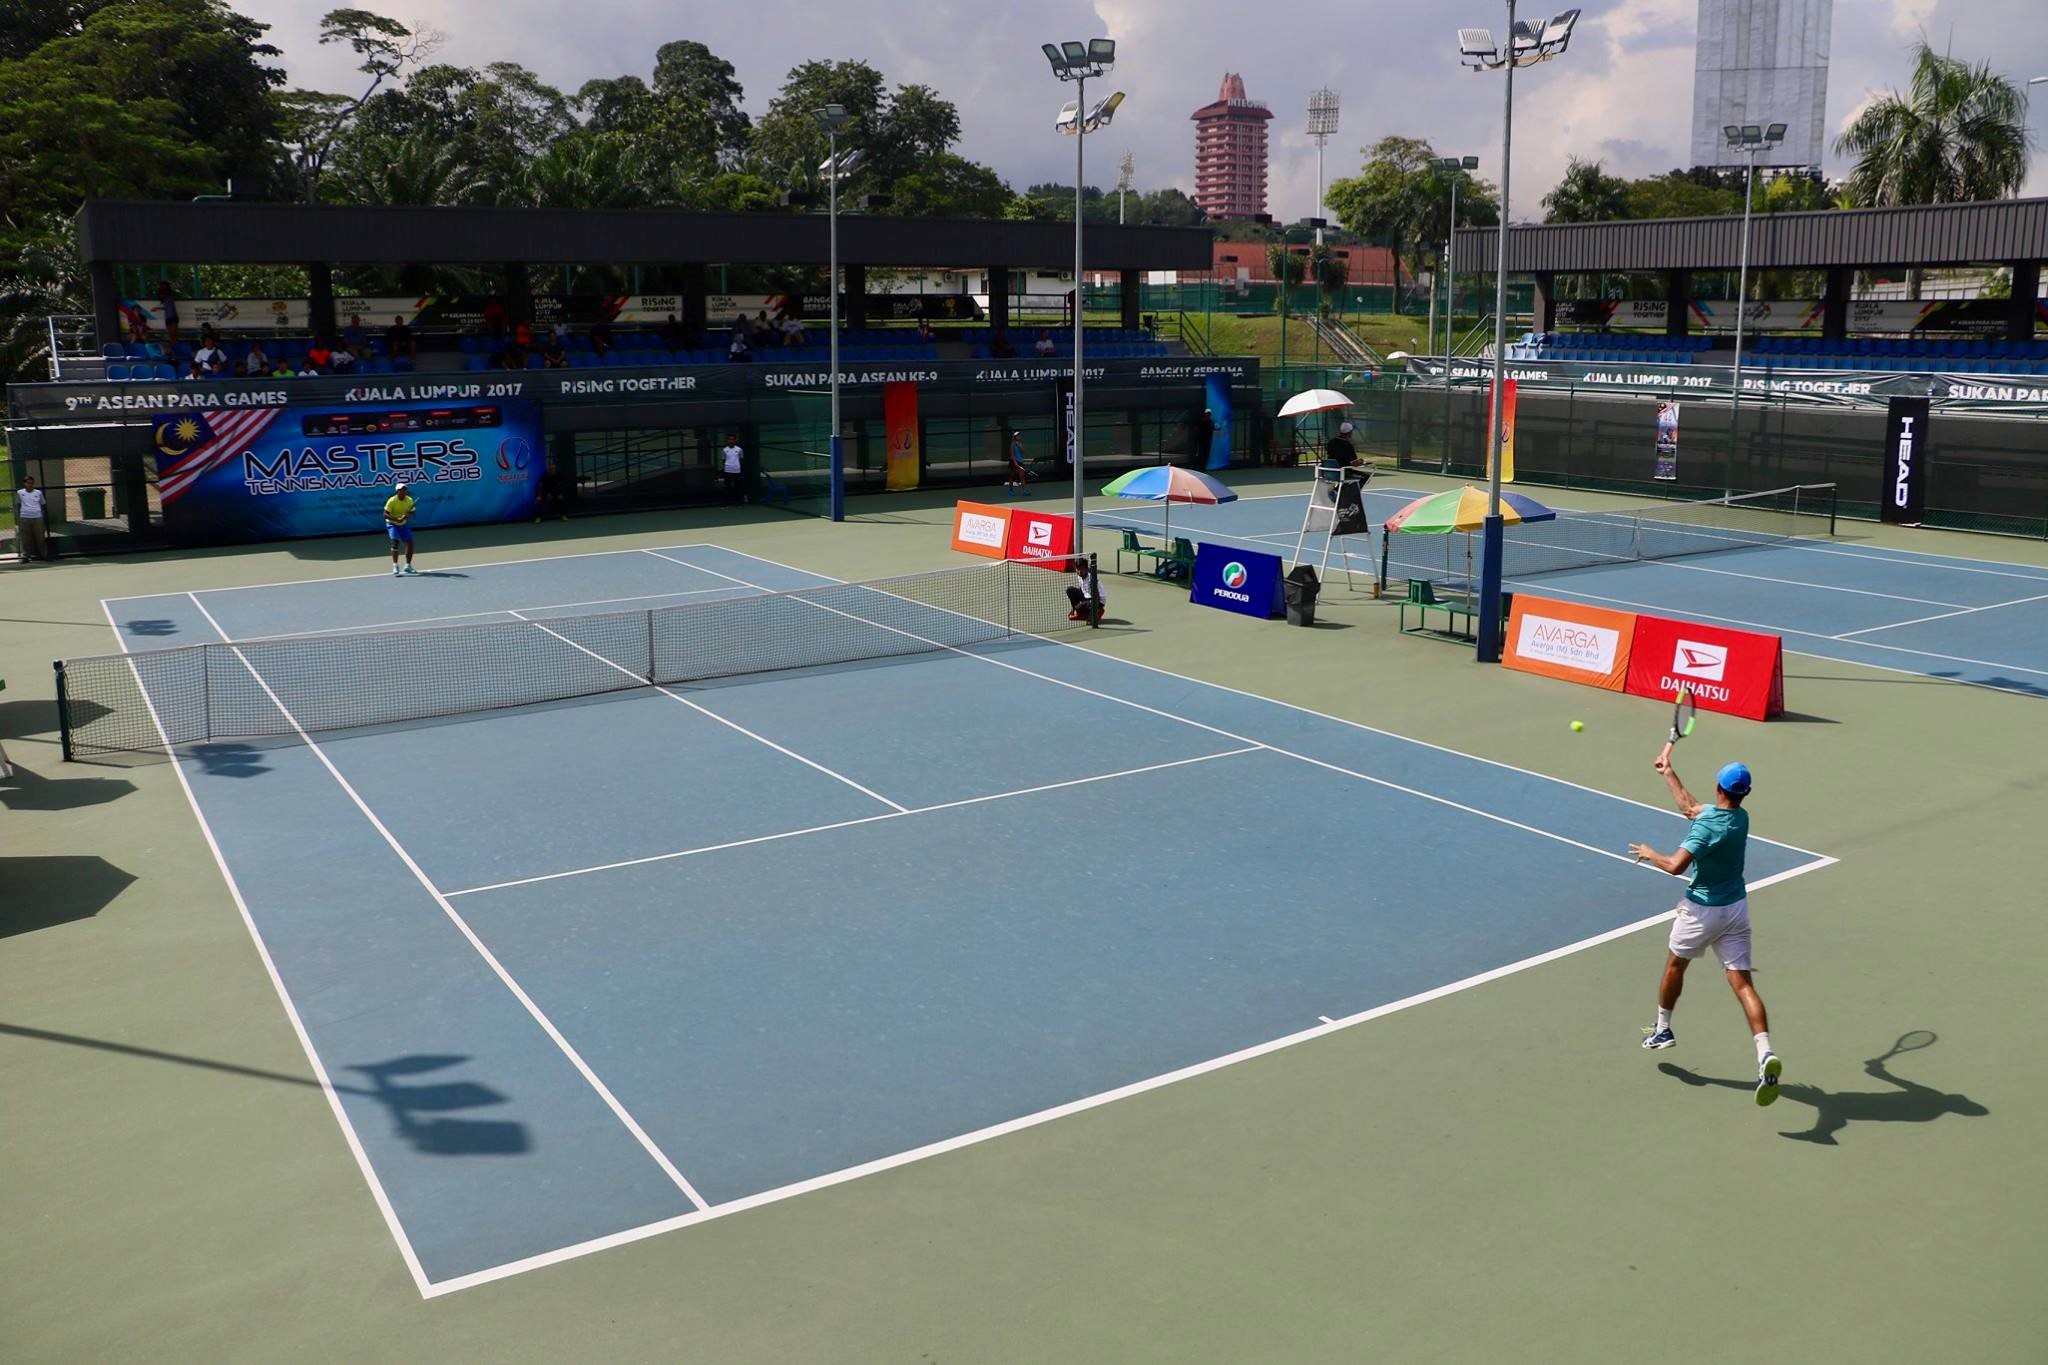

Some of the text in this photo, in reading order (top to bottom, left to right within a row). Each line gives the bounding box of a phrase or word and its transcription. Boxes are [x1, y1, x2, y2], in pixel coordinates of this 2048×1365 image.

[642, 297, 675, 306] RISING
[1633, 302, 1666, 311] RISING
[765, 373, 816, 387] SUKAN
[860, 372, 906, 383] ASEAN
[1511, 370, 1548, 381] GAMES
[1583, 372, 1712, 387] KUALA LUMPUR 2017
[345, 383, 523, 401] KUALA LUMPUR 2017
[561, 376, 696, 394] RISING TOGETHER
[1743, 379, 1871, 395] RISING TOGETHER
[1948, 384, 2013, 400] SUKAN
[97, 395, 163, 410] ASEAN
[168, 393, 220, 408] PARA
[224, 391, 288, 406] GAMES
[1066, 392, 1074, 465] HEAD
[244, 440, 478, 480] MASTERS
[1895, 417, 1914, 507] HEAD
[435, 467, 481, 482] 2018
[1022, 545, 1053, 558] DAIHATSU
[1533, 624, 1599, 650] AVARGA
[1531, 639, 1554, 652] Avarga
[1570, 647, 1584, 657] Sdn
[1585, 650, 1600, 660] Bhd
[1660, 676, 1730, 702] DAIHATSU
